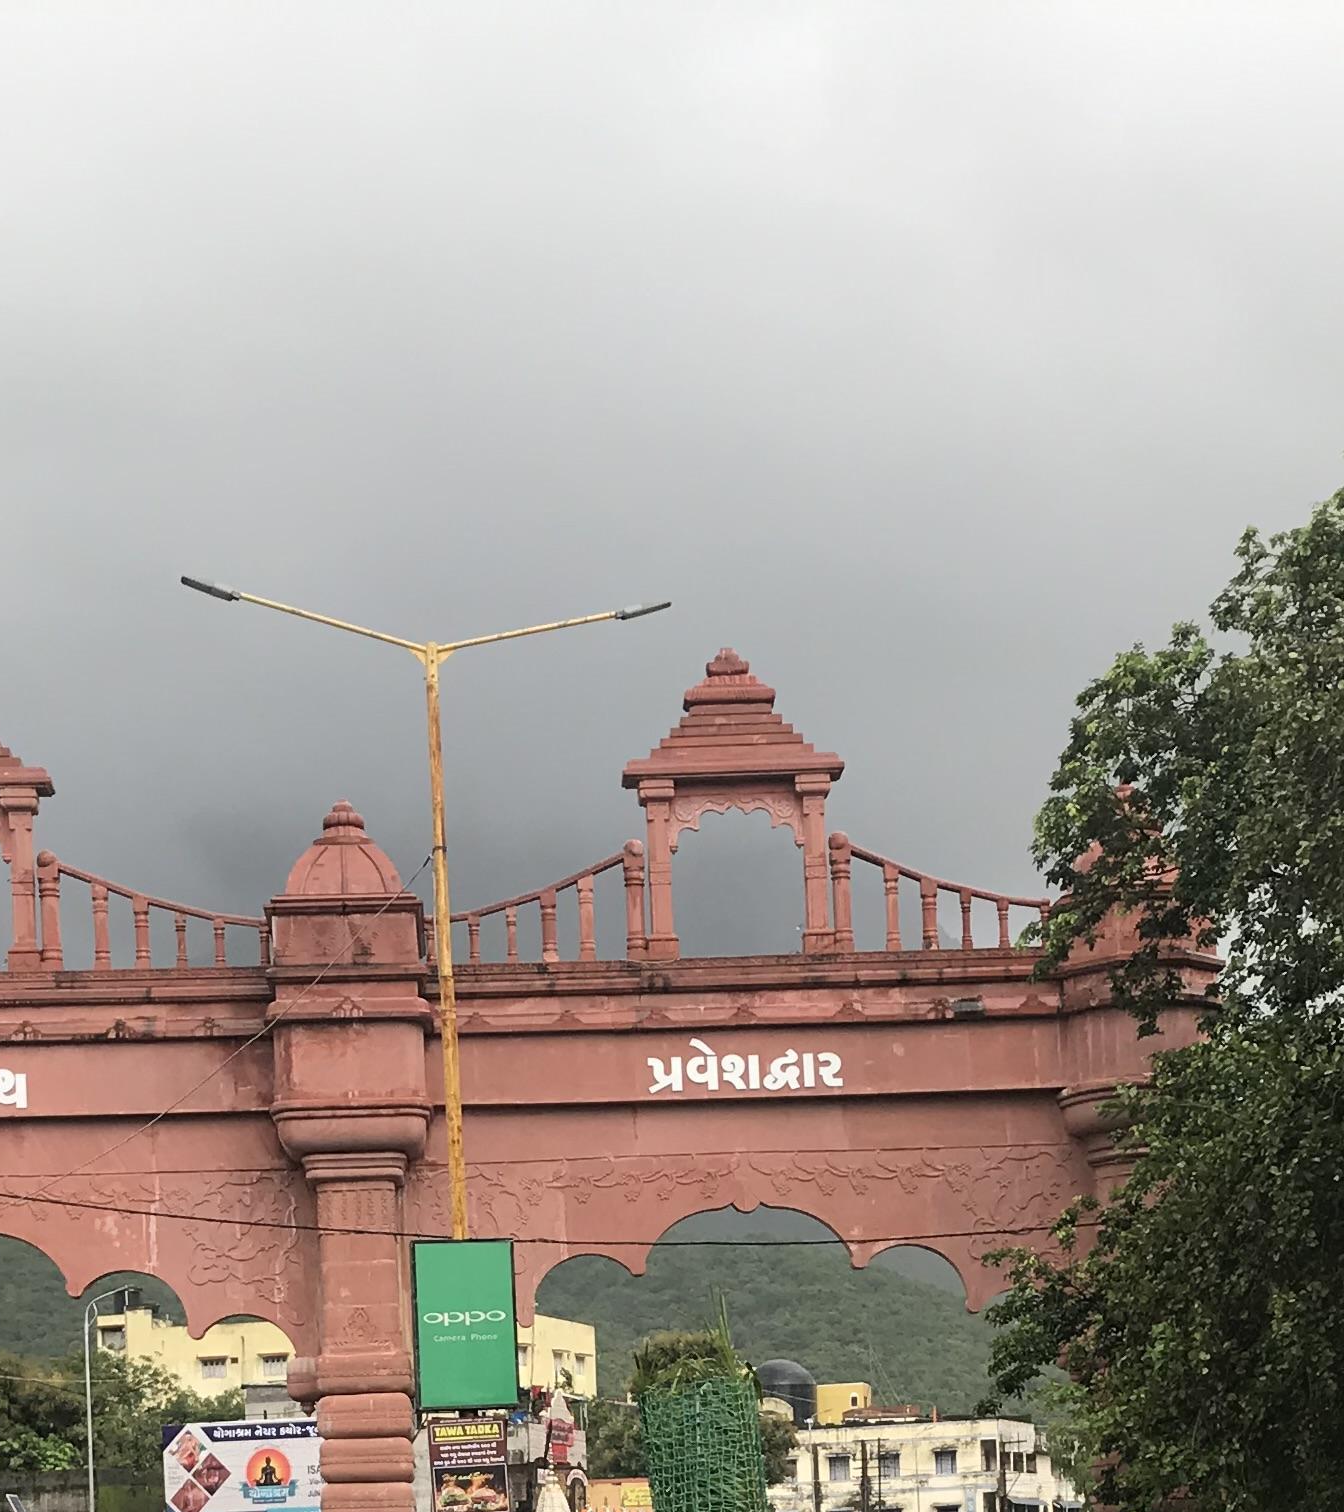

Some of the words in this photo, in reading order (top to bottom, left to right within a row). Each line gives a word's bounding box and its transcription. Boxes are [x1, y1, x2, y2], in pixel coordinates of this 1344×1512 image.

[647, 1037, 844, 1094] પ્રવેશદ્વાર
[470, 1333, 498, 1341] Phone
[433, 1425, 464, 1437] TAWA
[464, 1423, 500, 1435] TADKA
